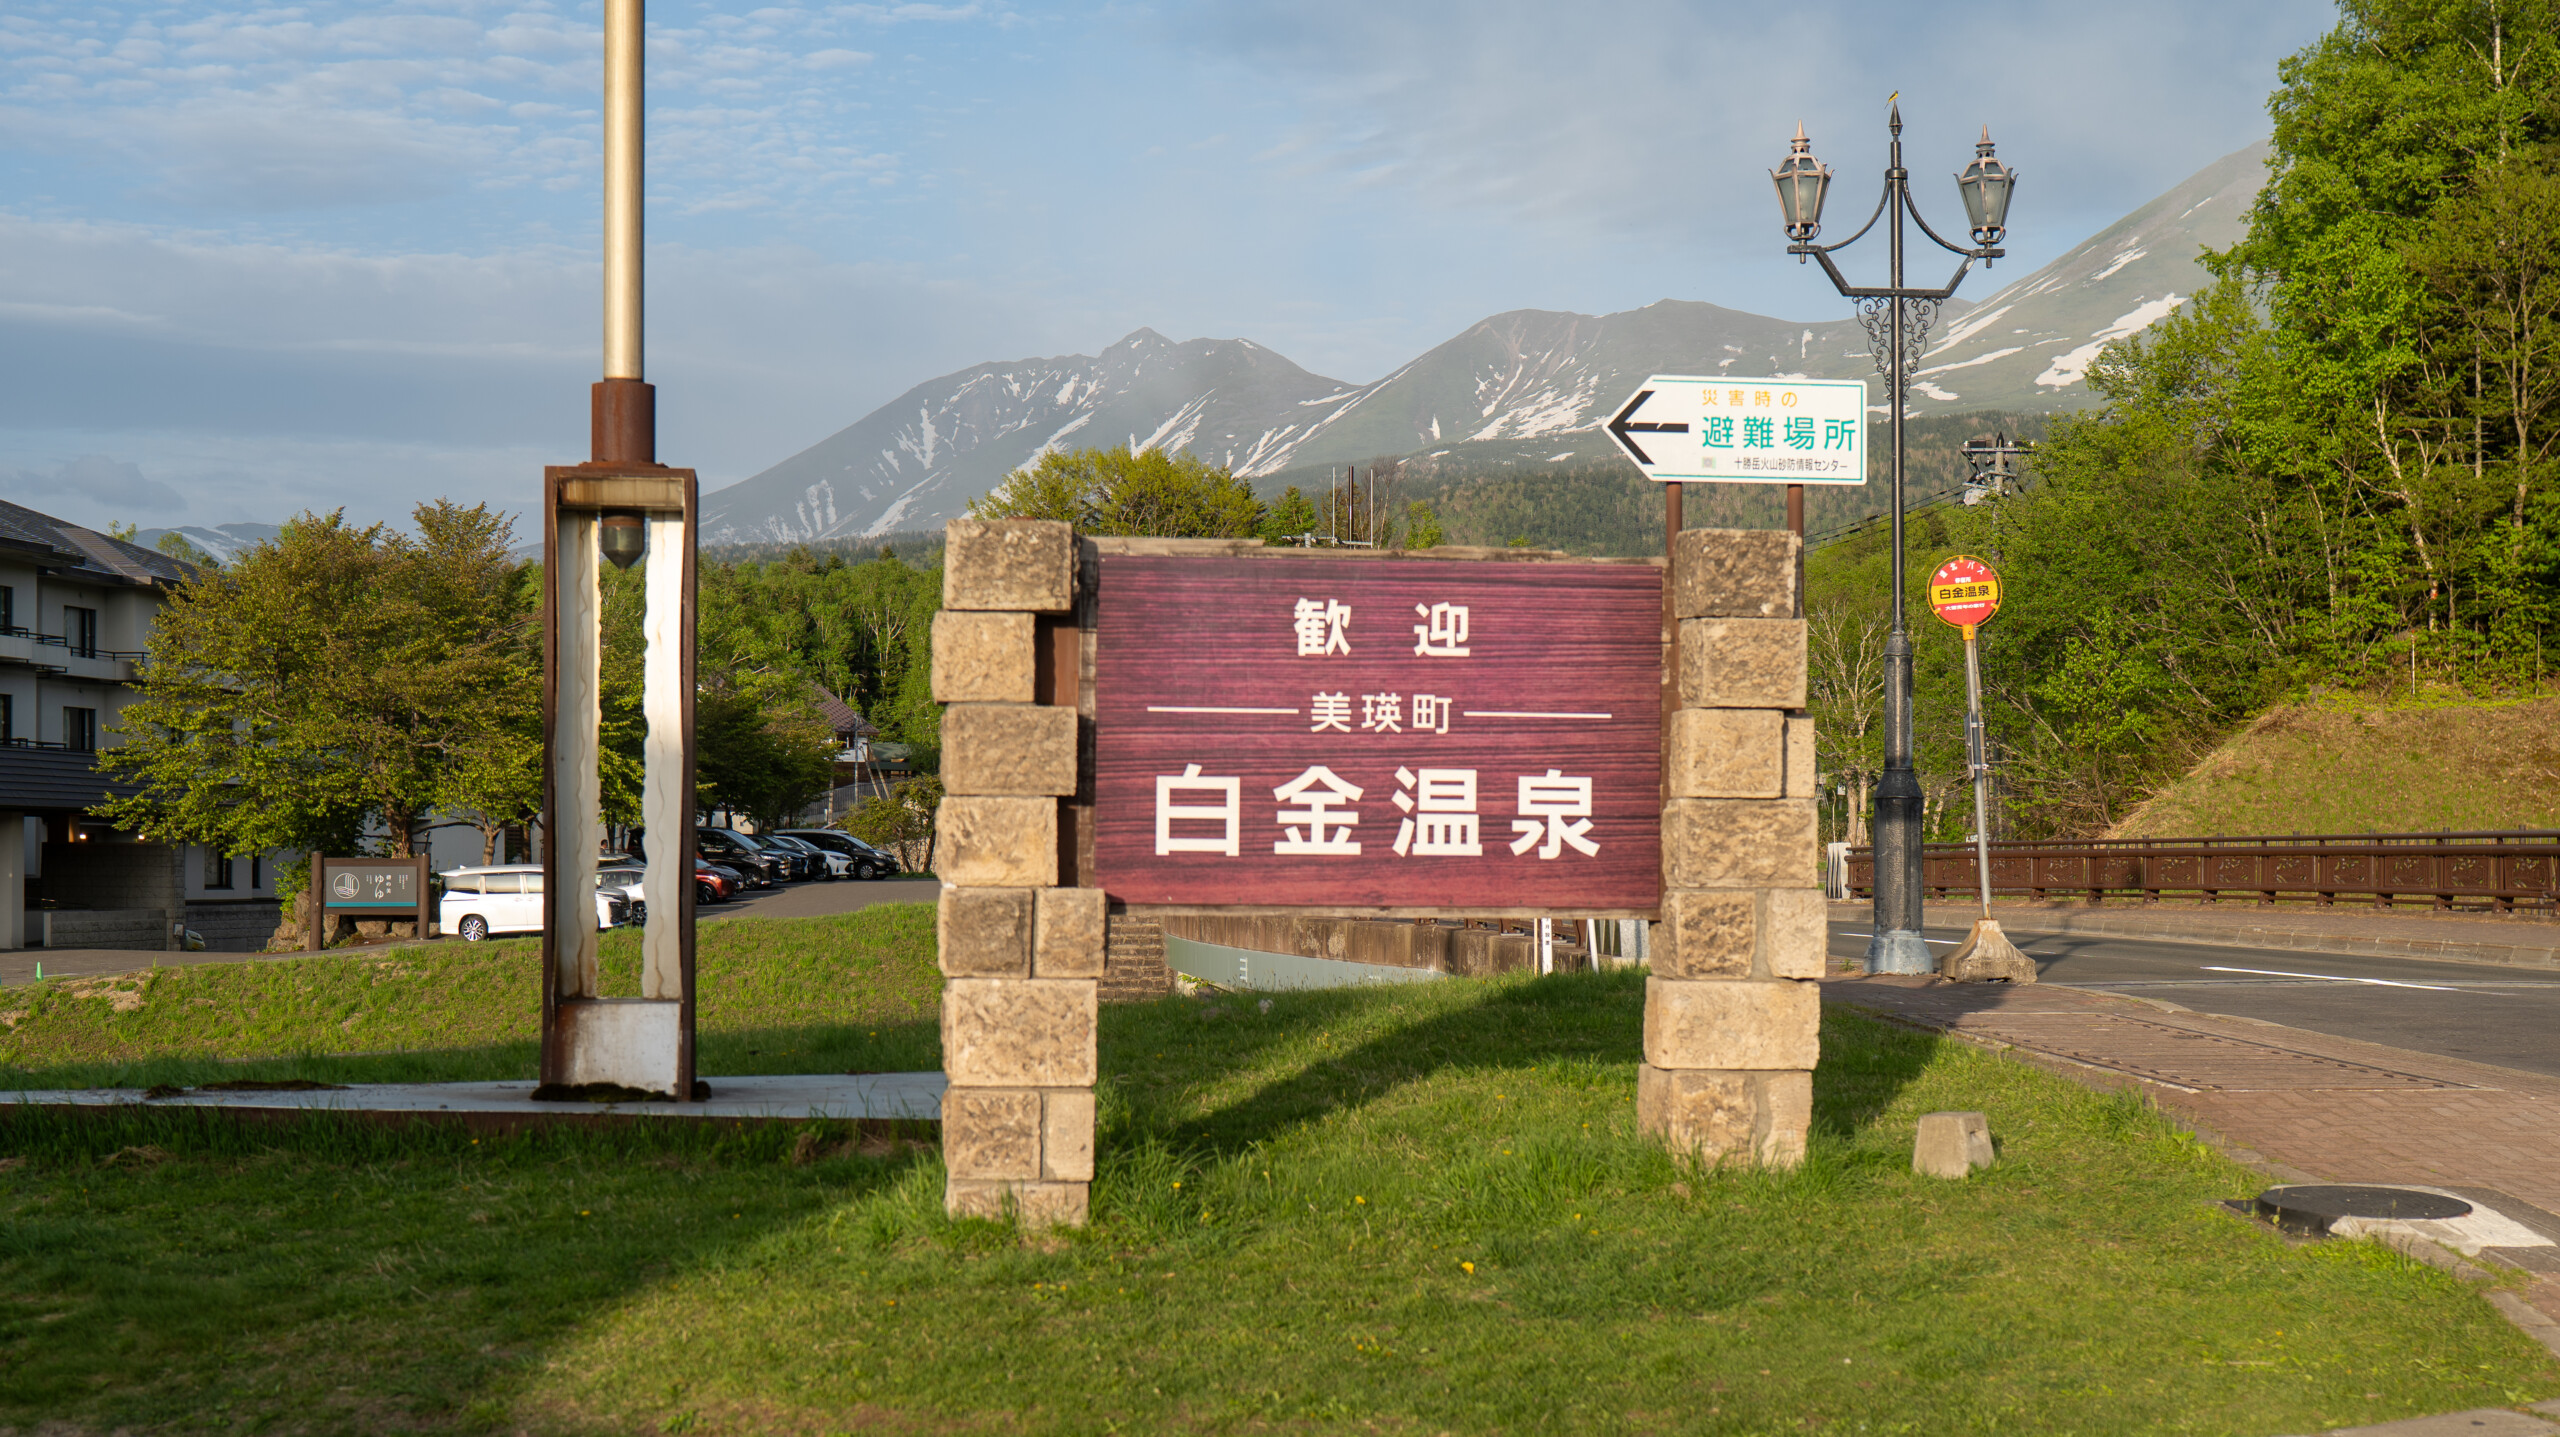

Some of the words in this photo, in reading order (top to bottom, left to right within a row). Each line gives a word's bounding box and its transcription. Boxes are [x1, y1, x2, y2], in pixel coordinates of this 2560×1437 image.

[1702, 388, 1798, 408] 災害時の
[1702, 416, 1856, 452] 避難場所
[1734, 457, 1848, 472] 十勝岳火山砂防情報センター
[1939, 585, 1990, 600] 白金温泉
[1293, 598, 1471, 657] 歓迎
[1310, 691, 1453, 734] 美瑛町
[1155, 763, 1601, 860] 白金温泉
